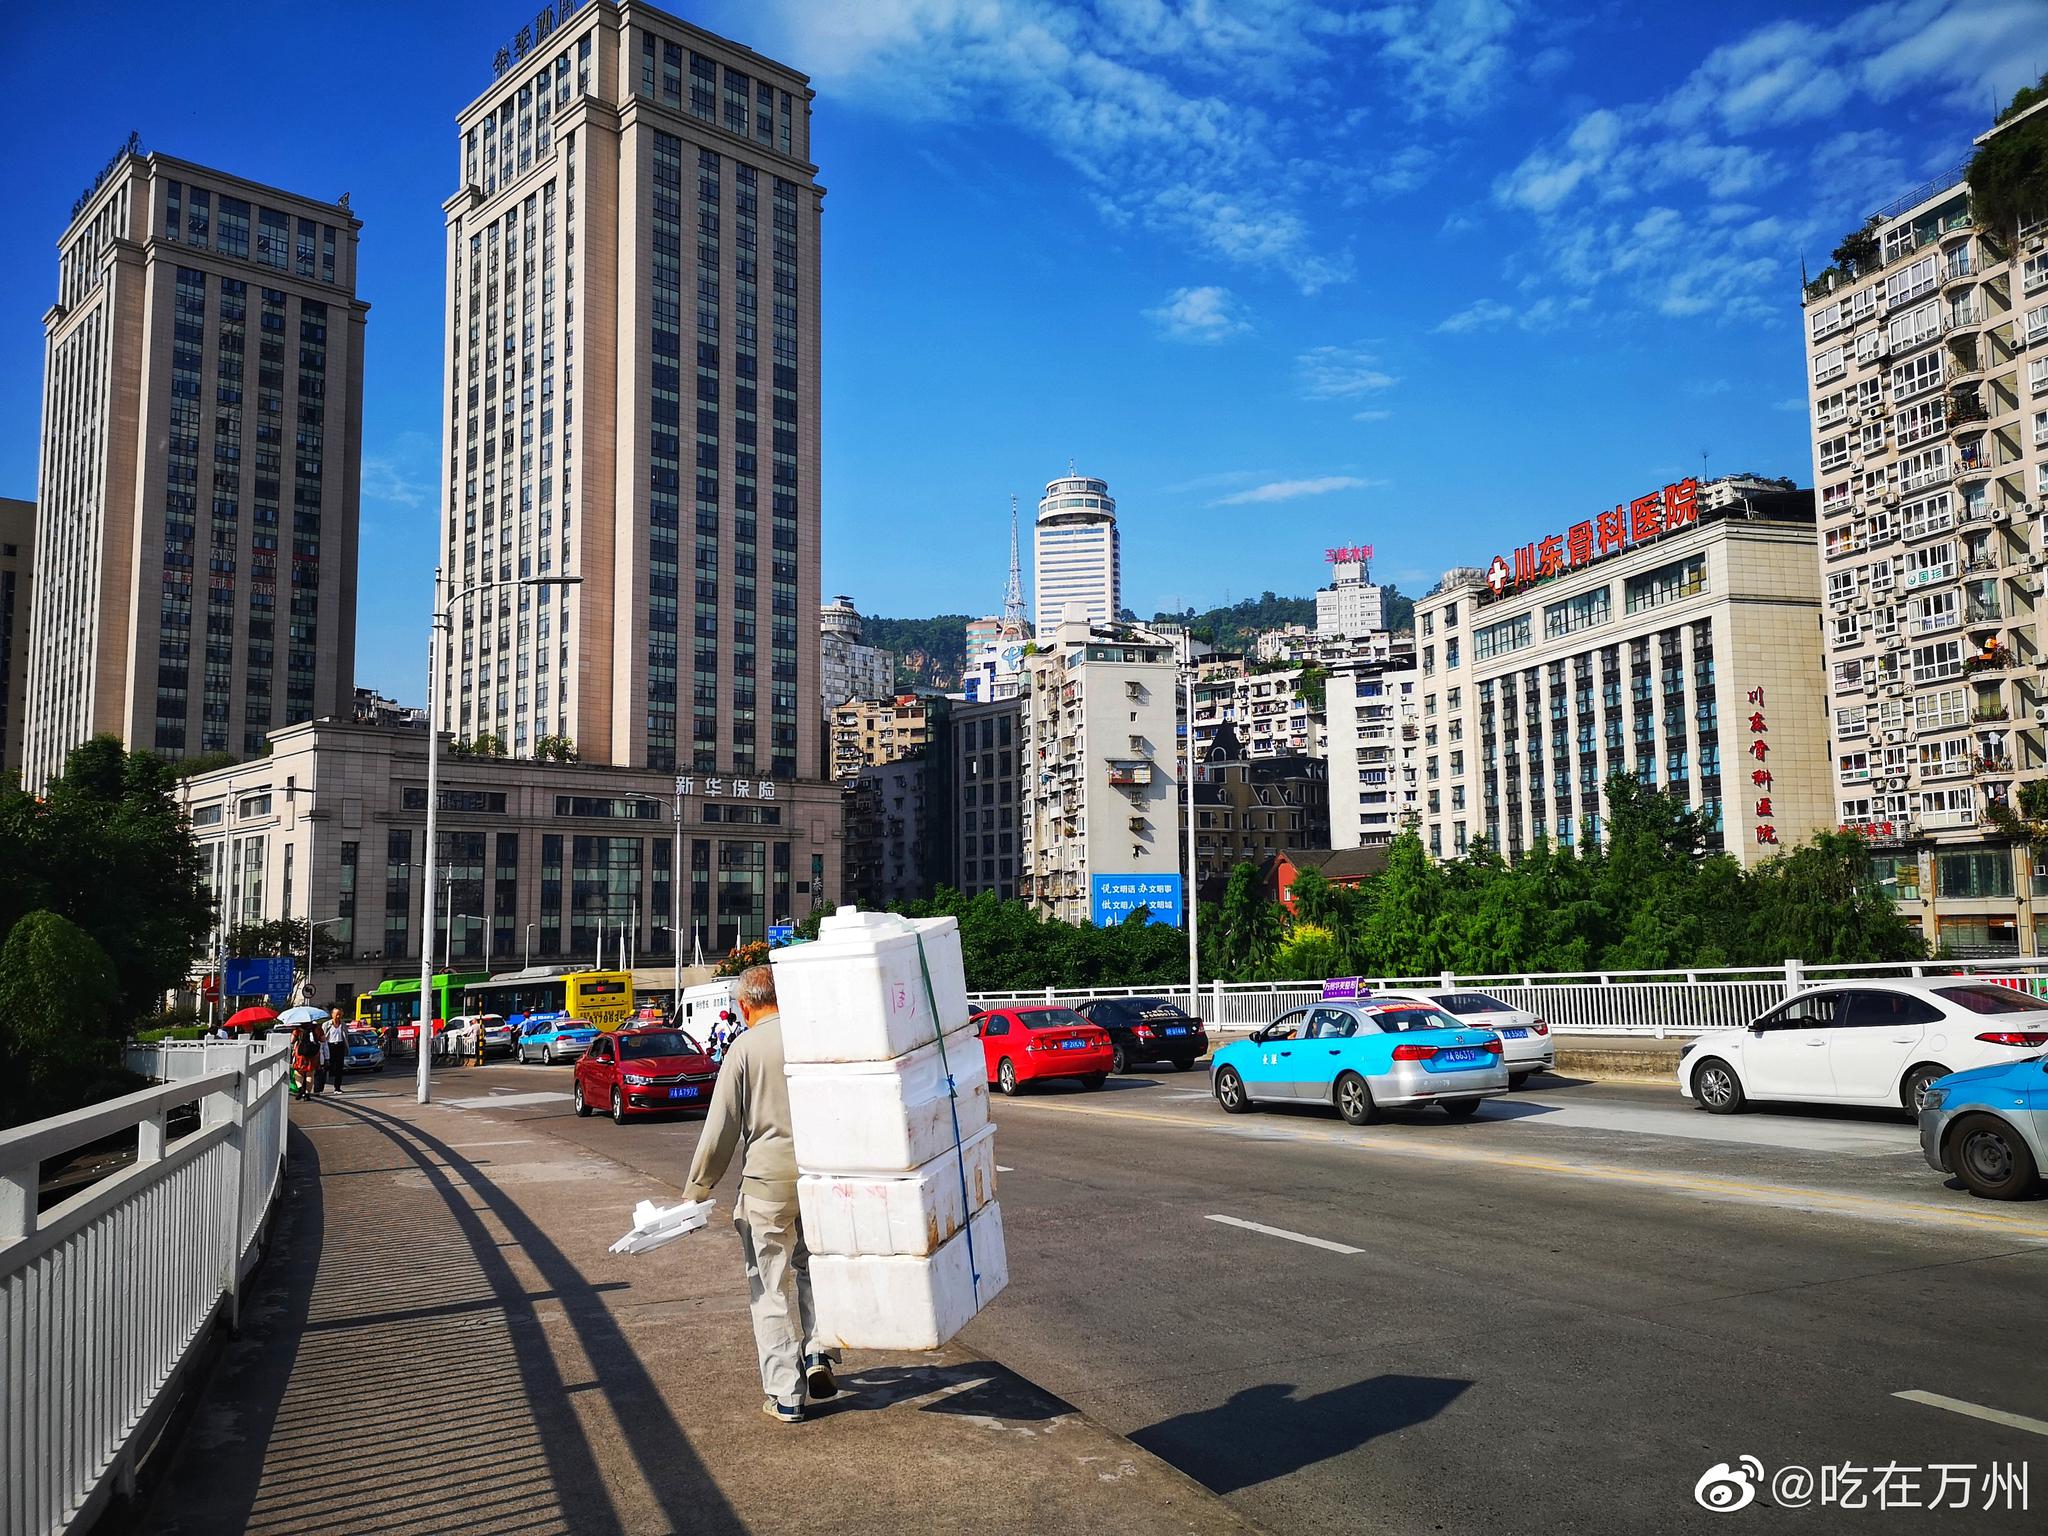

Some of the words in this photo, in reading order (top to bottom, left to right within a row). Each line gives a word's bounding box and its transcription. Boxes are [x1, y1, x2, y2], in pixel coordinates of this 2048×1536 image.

[1514, 476, 1698, 587] 川东骨科医院
[675, 776, 775, 800] 新华保险
